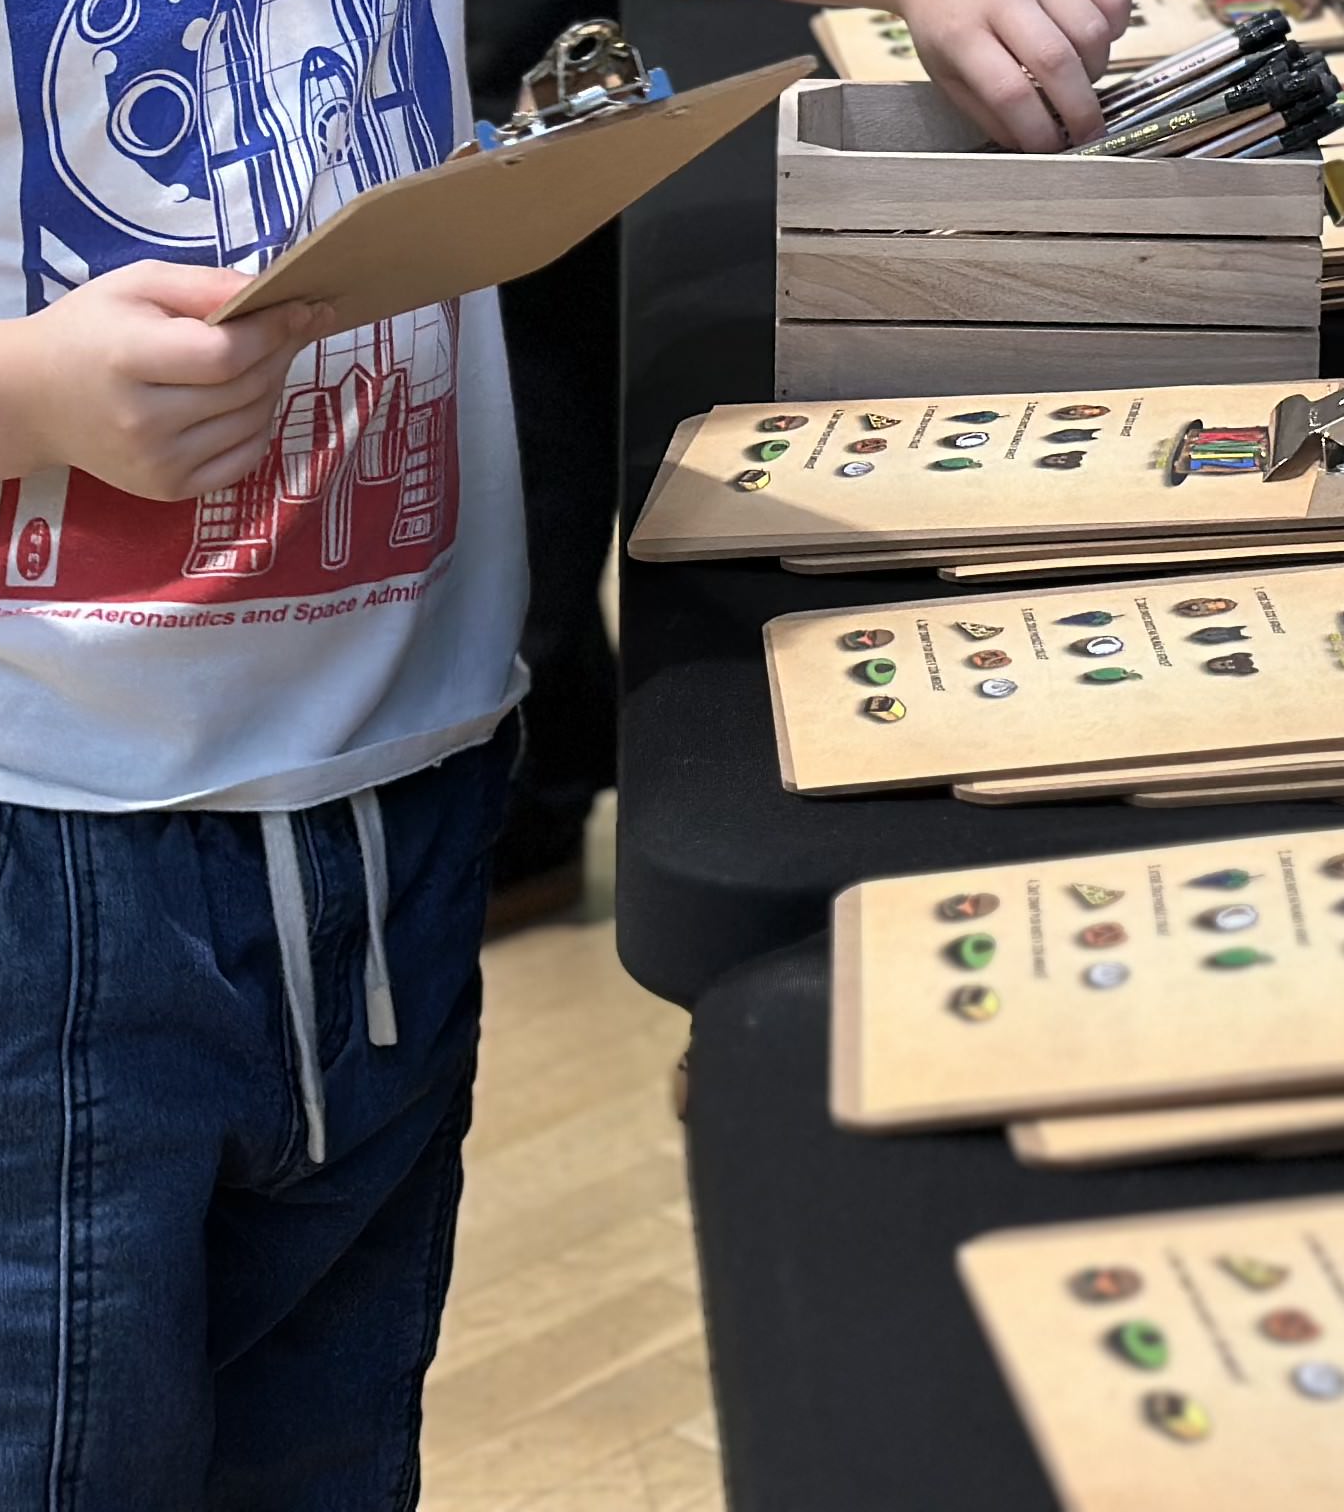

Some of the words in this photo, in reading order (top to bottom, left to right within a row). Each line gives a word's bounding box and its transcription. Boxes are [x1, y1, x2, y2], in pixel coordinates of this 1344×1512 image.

[84, 607, 235, 629] Aeronautics
[241, 604, 290, 625] and
[293, 596, 358, 626] Space
